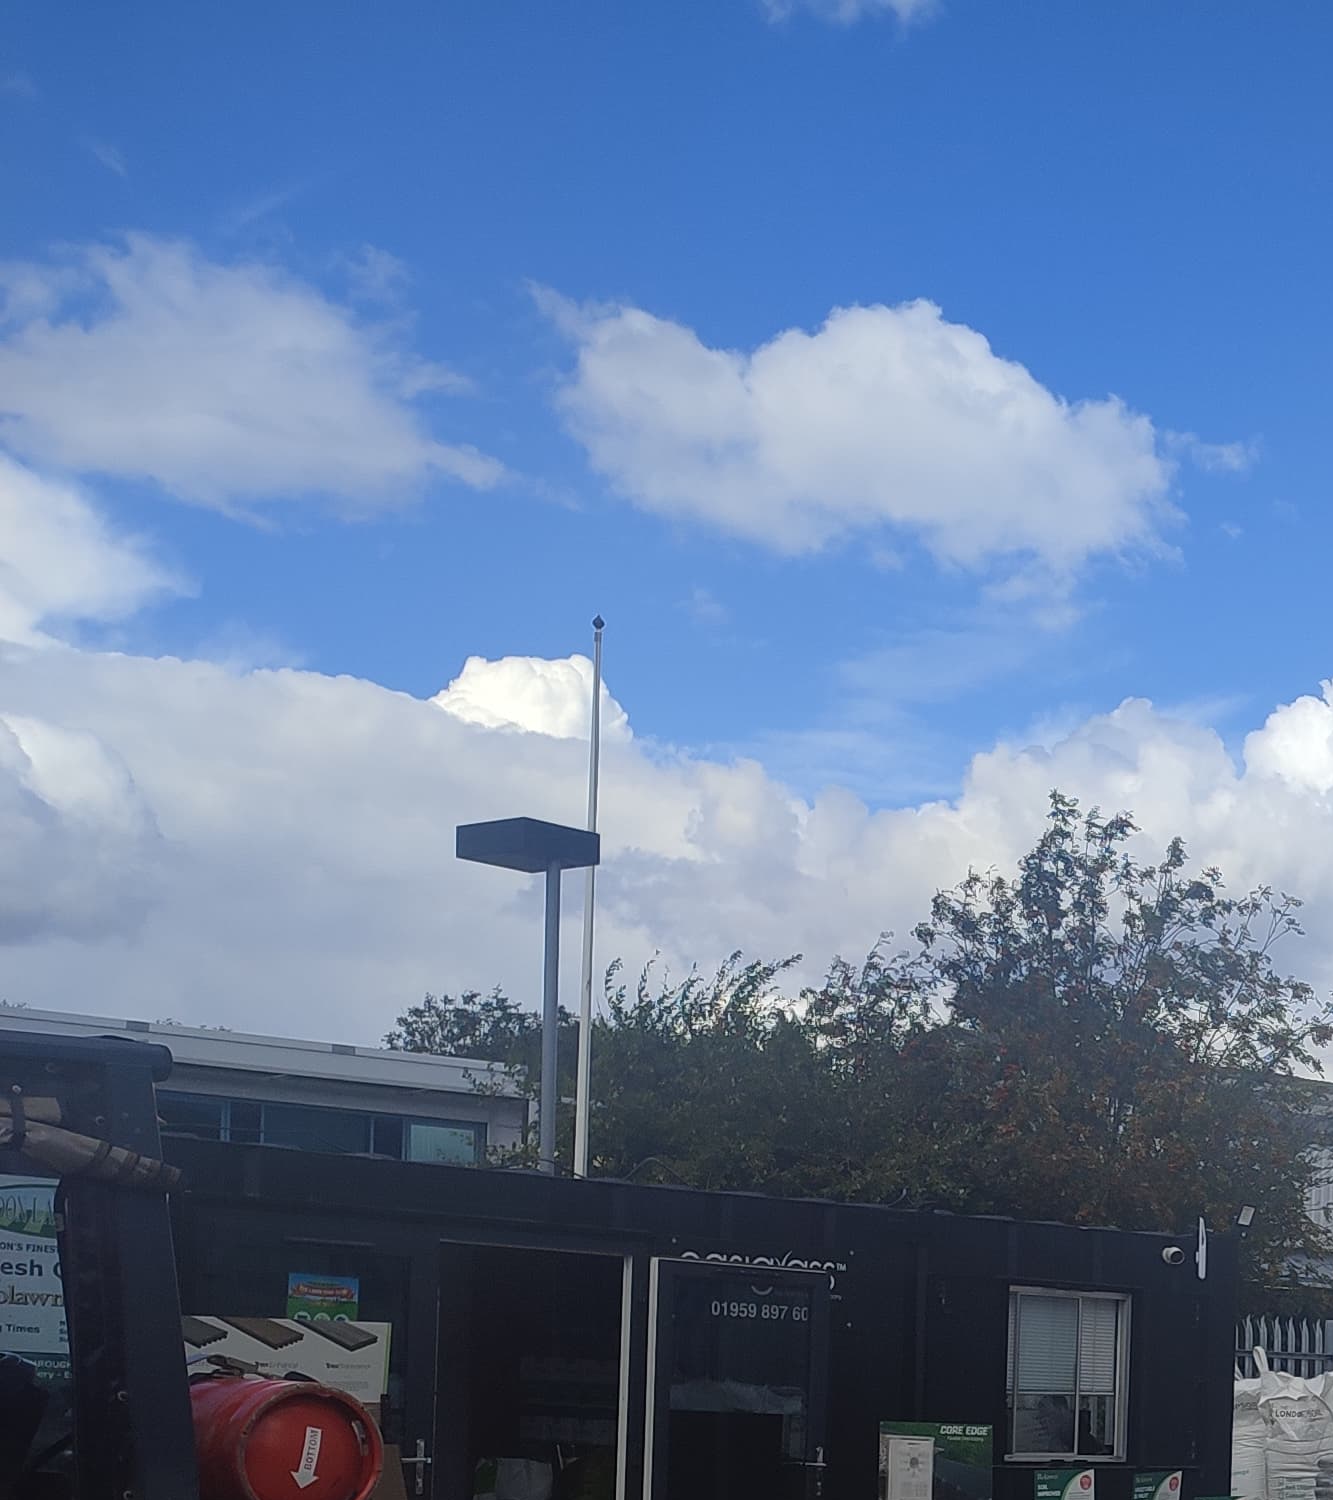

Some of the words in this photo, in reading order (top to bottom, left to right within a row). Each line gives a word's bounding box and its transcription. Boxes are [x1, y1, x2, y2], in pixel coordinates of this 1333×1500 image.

[711, 1300, 756, 1319] 01959
[761, 1304, 788, 1321] 897
[6, 1323, 40, 1334] Times
[940, 1425, 964, 1435] CORE
[966, 1426, 989, 1436] EDGE
[305, 1428, 320, 1471] BOTTOM
